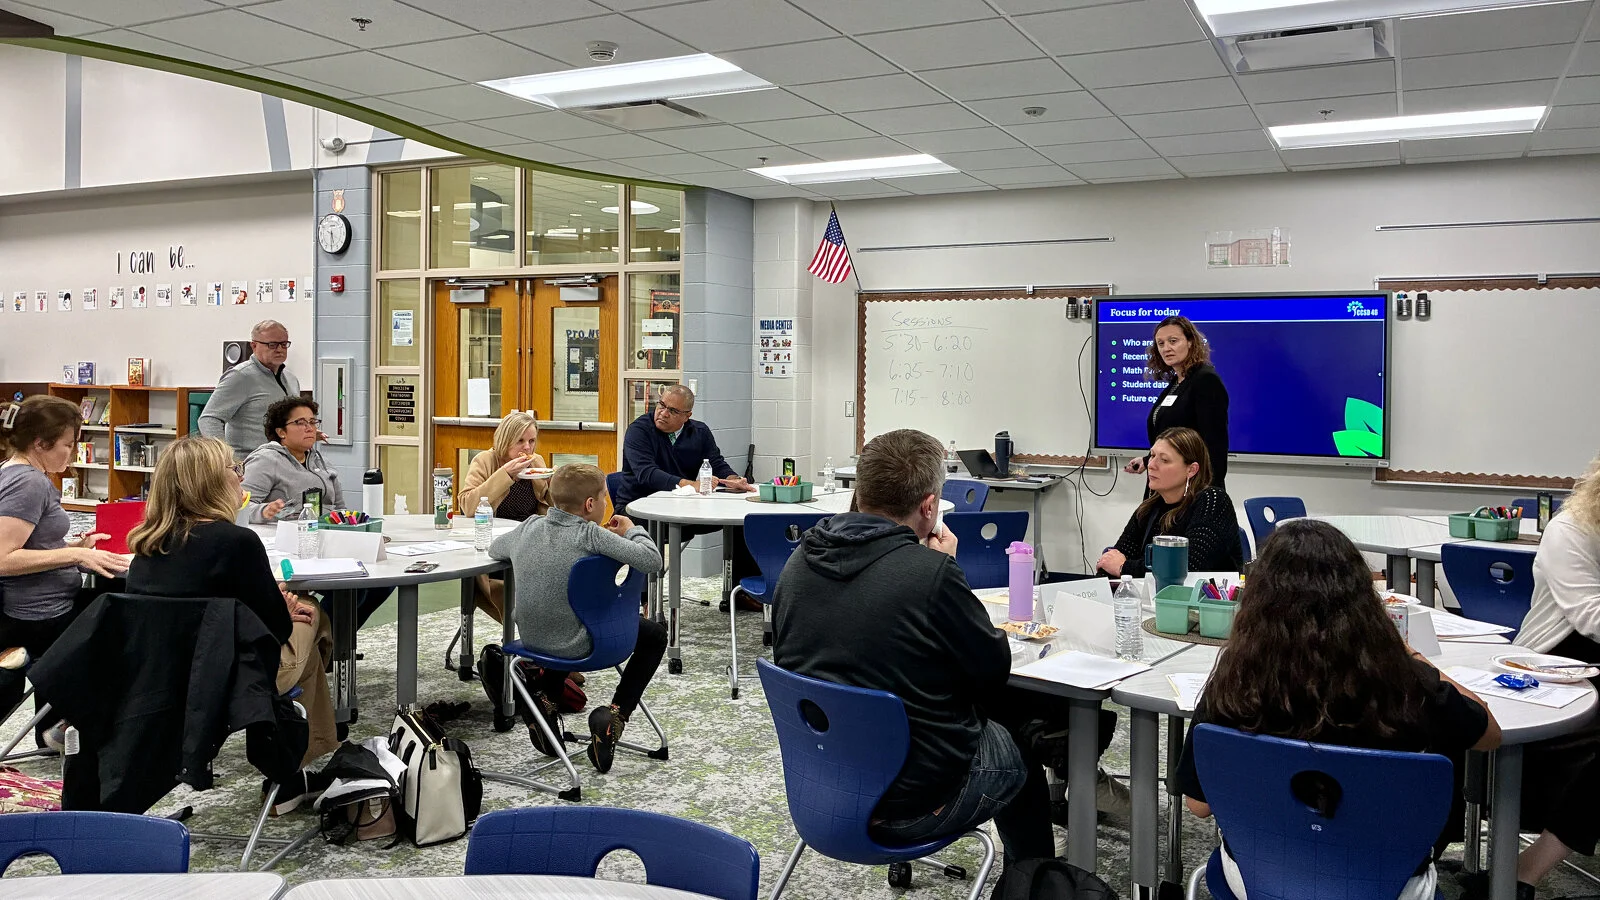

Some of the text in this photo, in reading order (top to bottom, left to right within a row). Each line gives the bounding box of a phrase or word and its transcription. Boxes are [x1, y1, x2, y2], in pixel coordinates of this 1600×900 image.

[130, 251, 155, 274] can
[1110, 307, 1181, 317] Focus for today
[760, 319, 793, 330] MEDIA CENTER
[566, 329, 585, 339] PTO
[1122, 338, 1154, 347] Who are
[1122, 352, 1148, 361] Recent
[1122, 366, 1142, 375] Math
[1122, 380, 1152, 389] Student
[1122, 394, 1146, 402] Future
